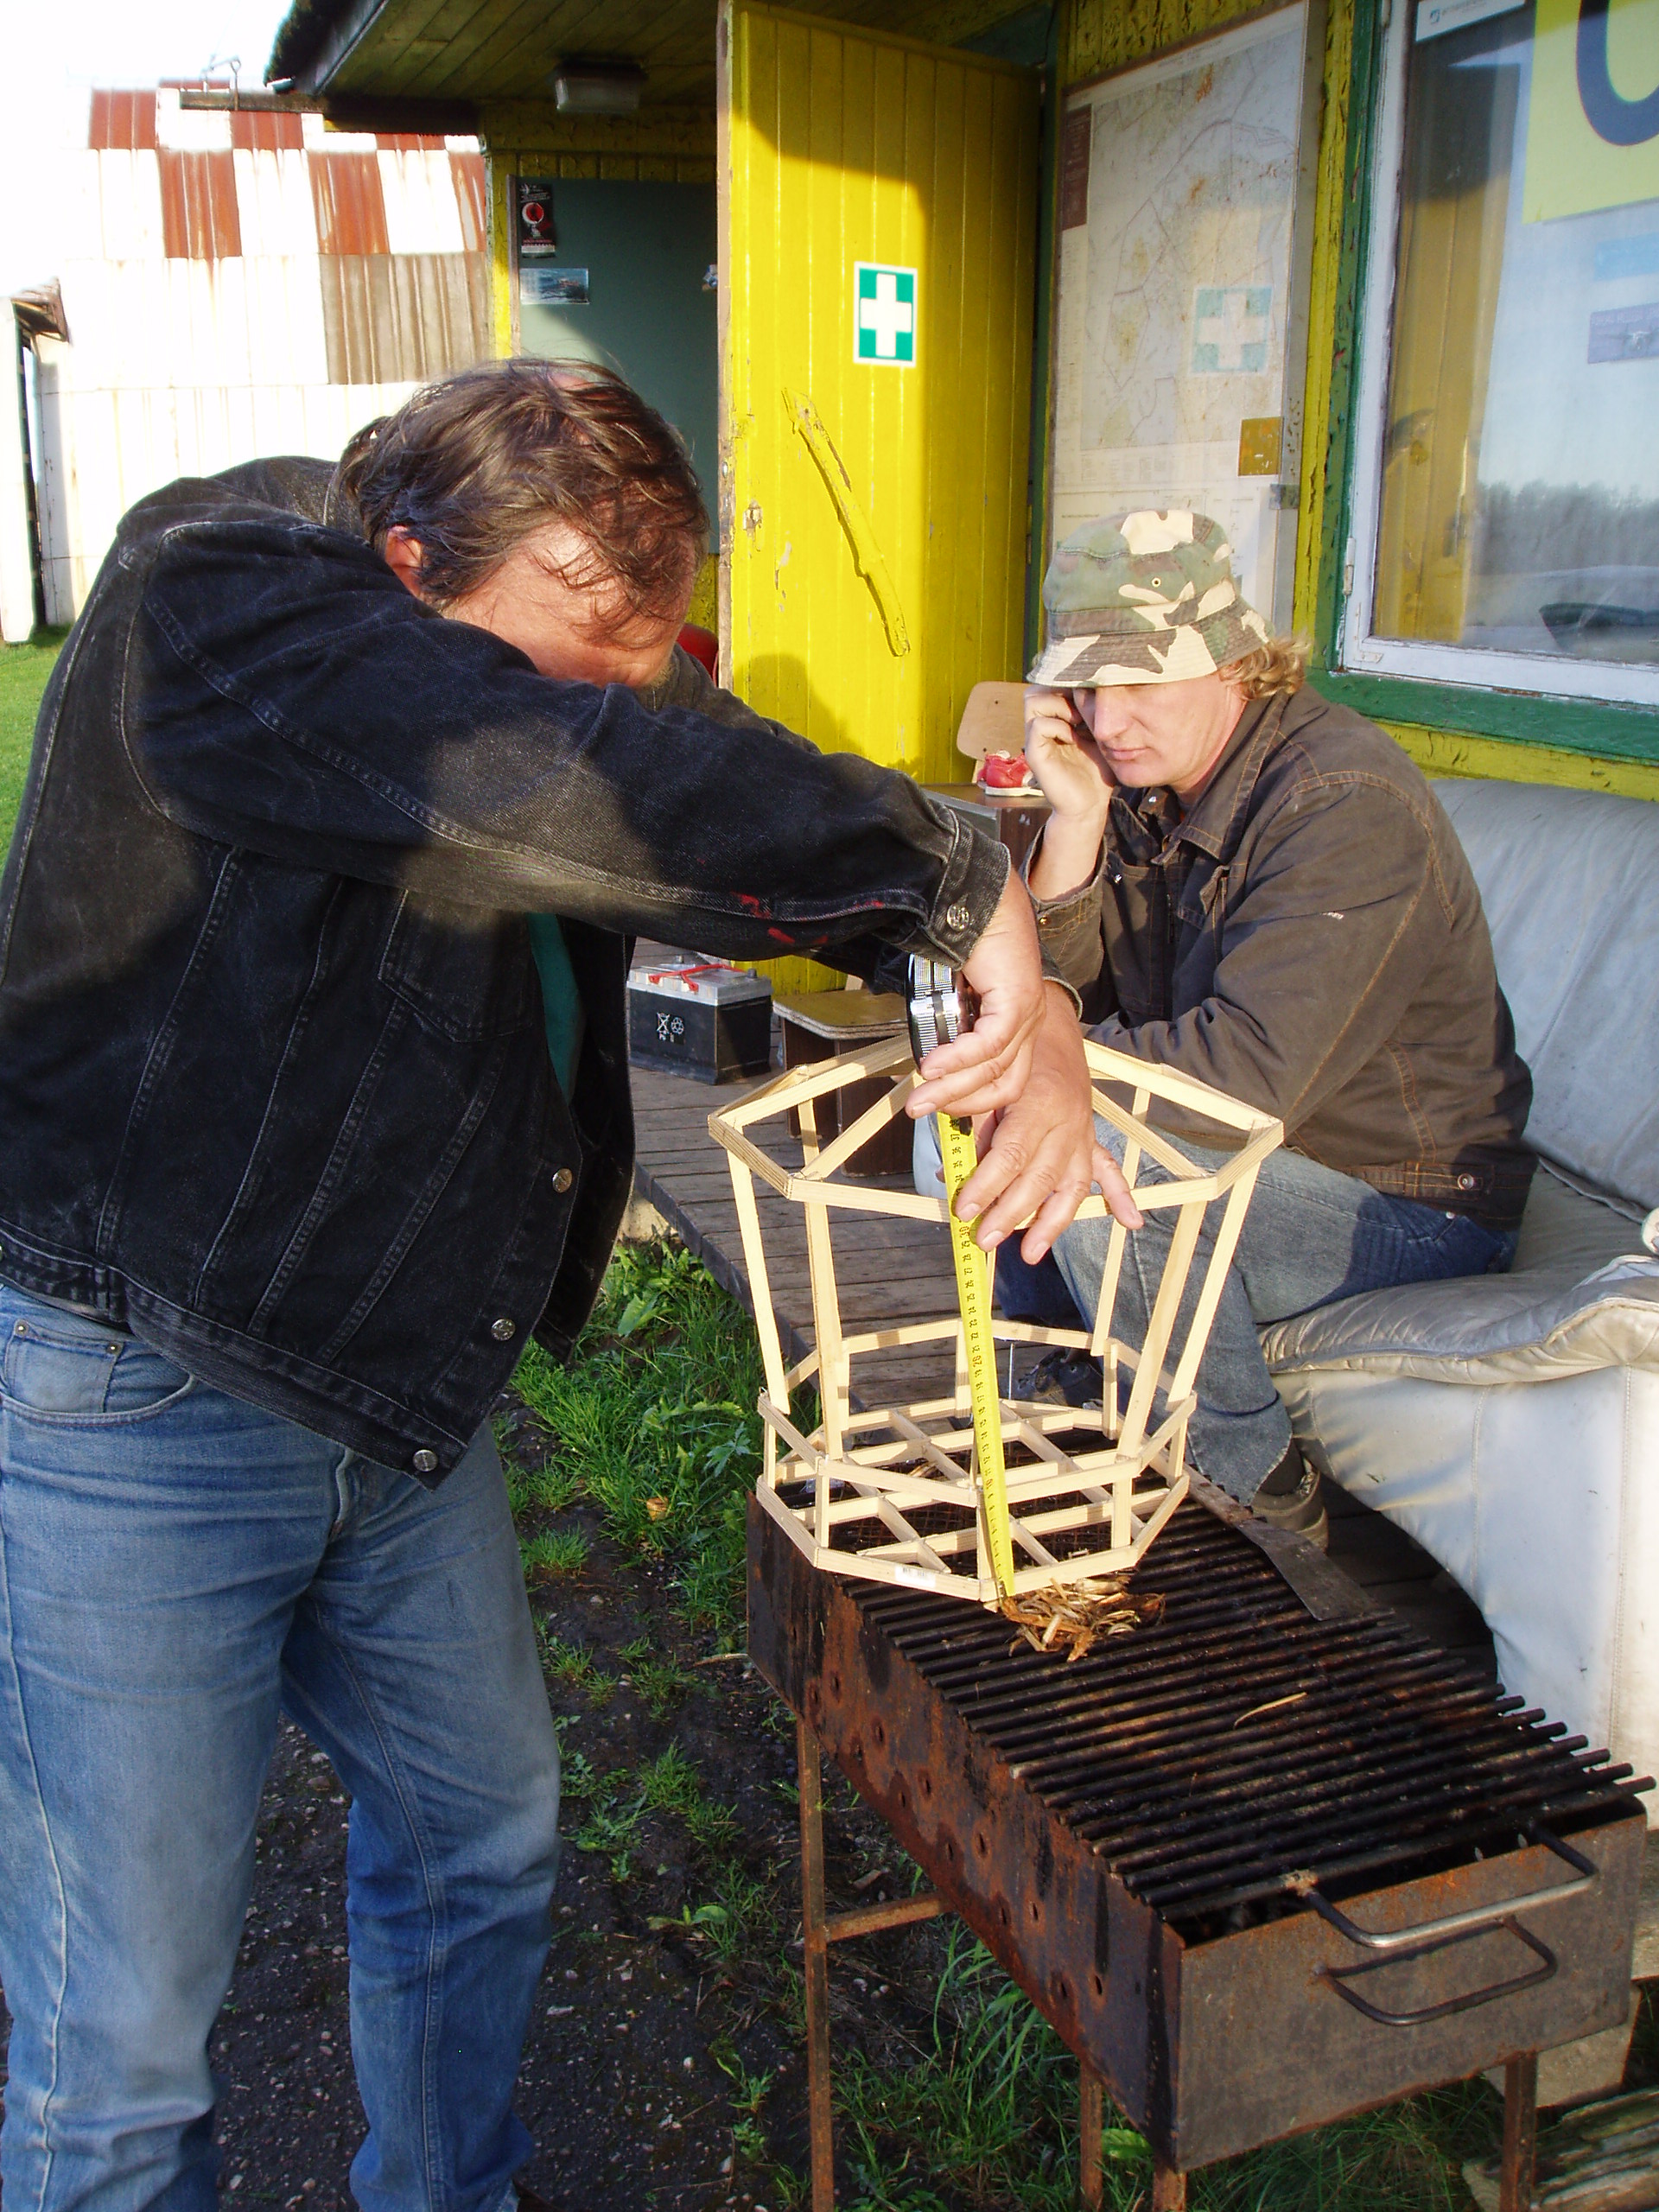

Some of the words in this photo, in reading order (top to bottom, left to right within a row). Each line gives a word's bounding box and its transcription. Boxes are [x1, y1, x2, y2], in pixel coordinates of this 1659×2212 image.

[951, 1146, 961, 1155] 36
[959, 1225, 969, 1238] 30
[963, 1267, 973, 1275] 27
